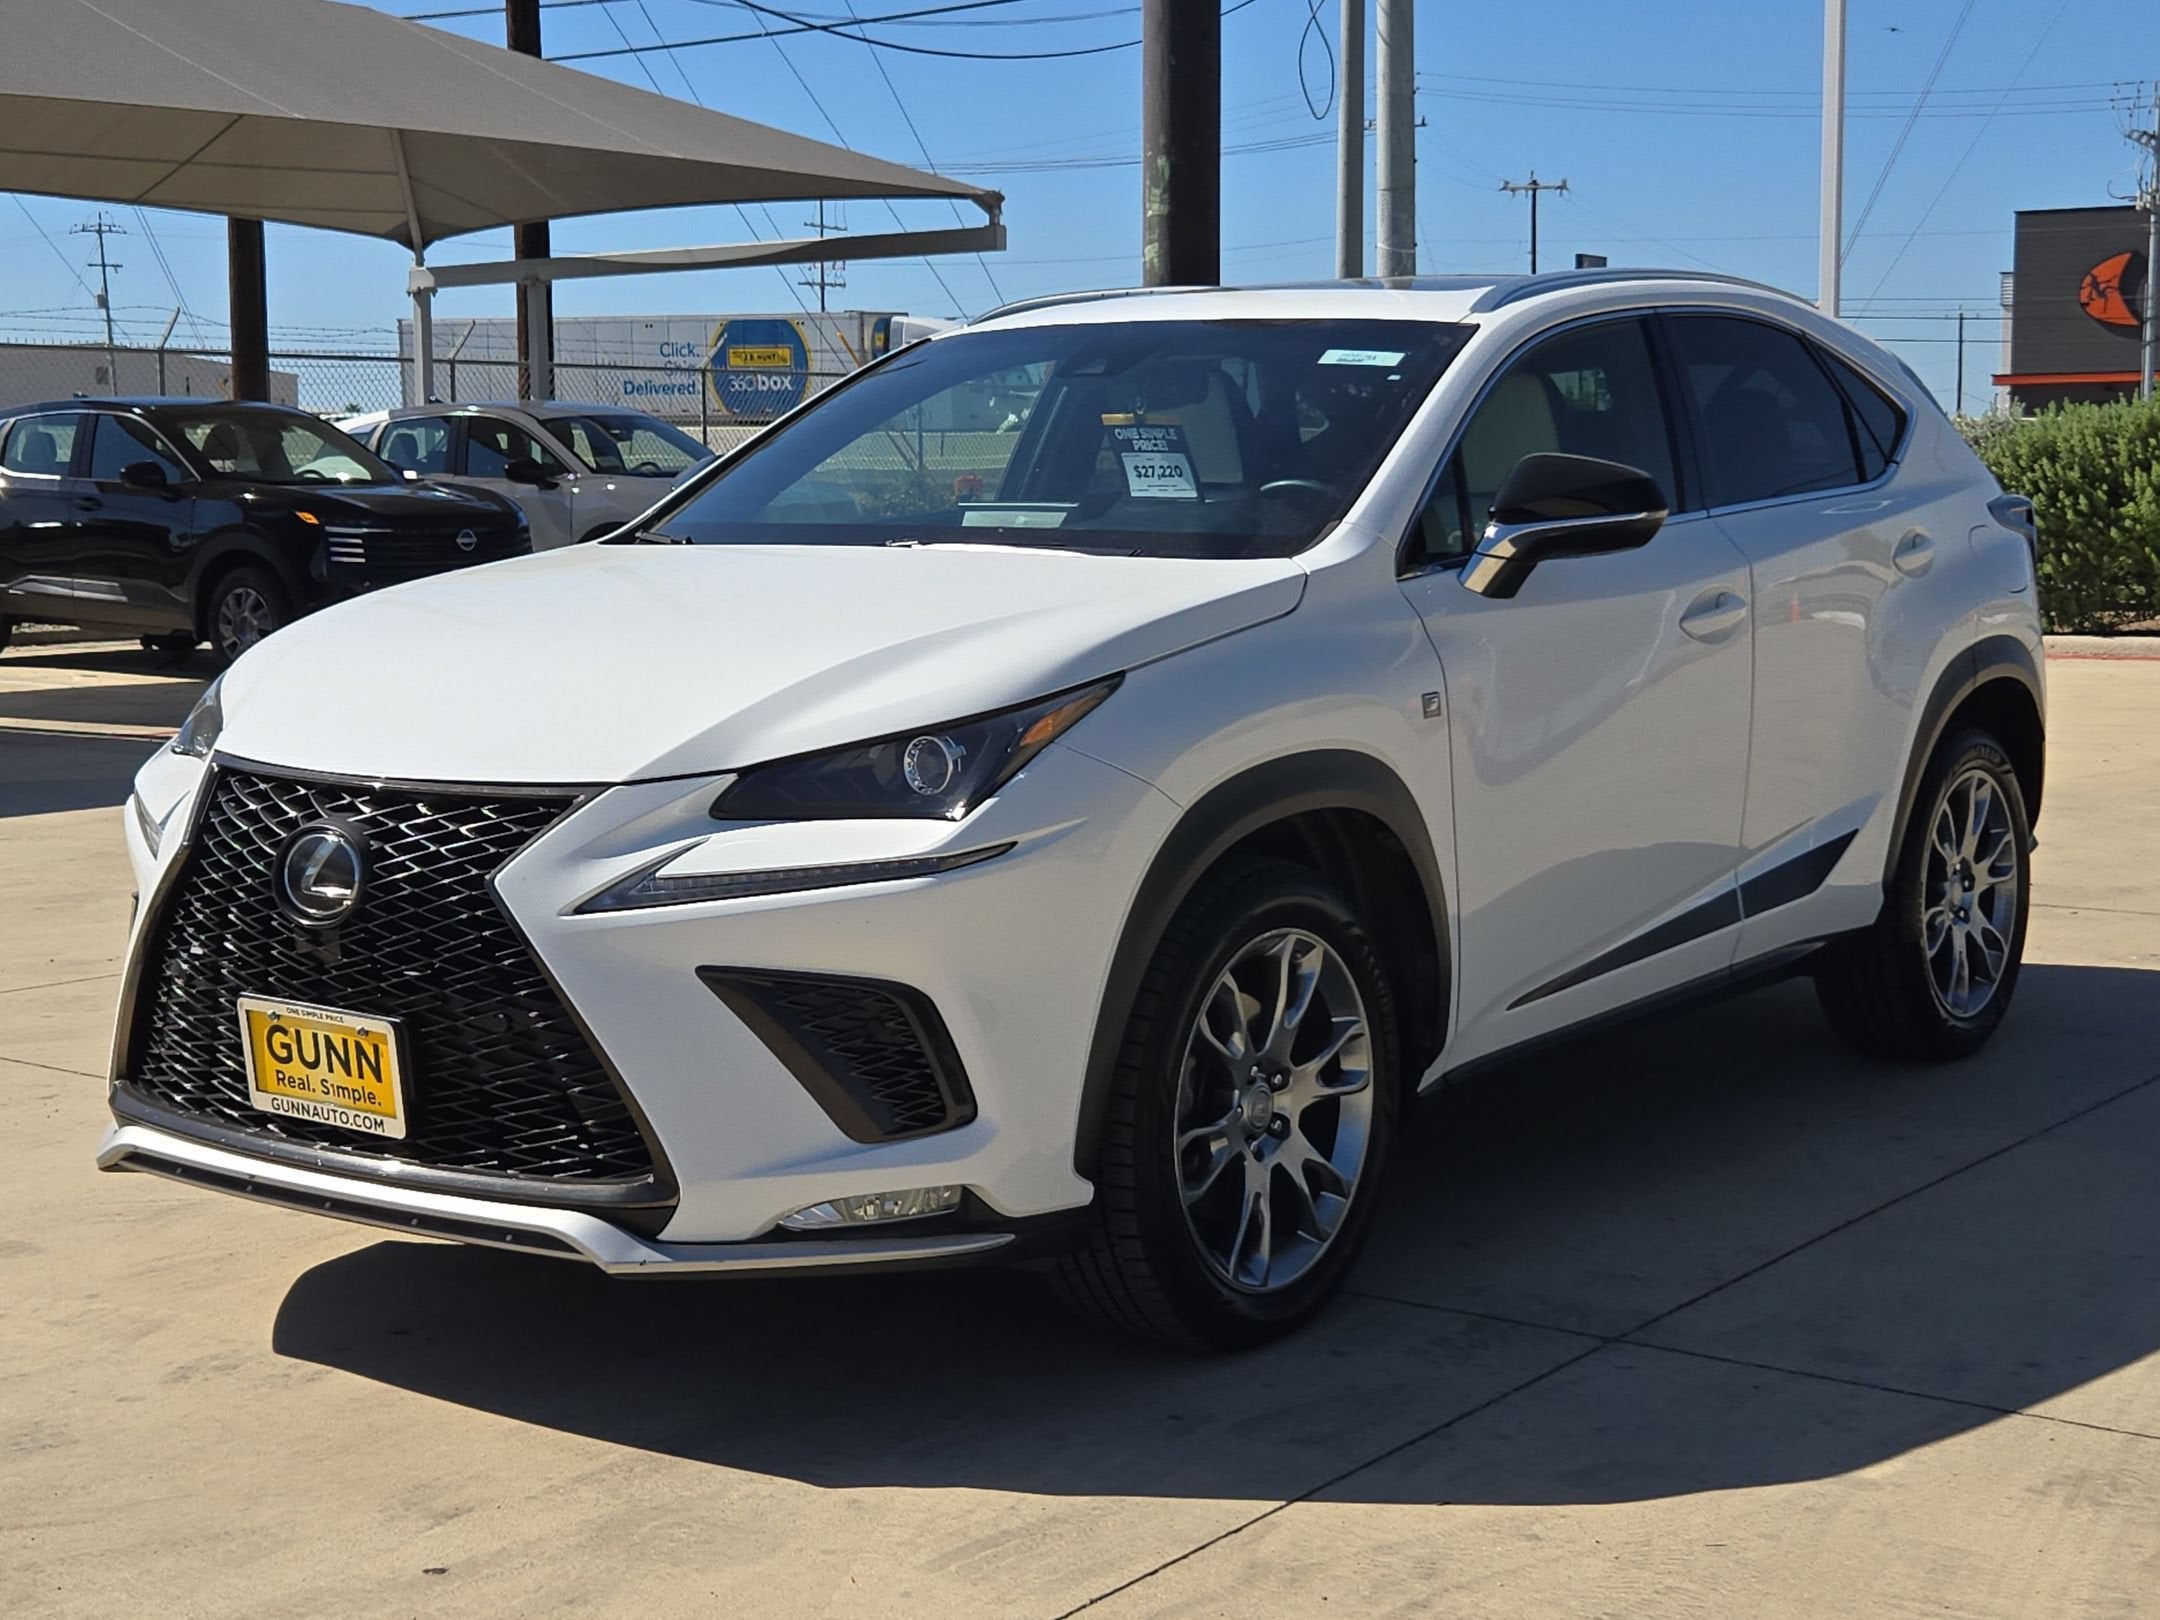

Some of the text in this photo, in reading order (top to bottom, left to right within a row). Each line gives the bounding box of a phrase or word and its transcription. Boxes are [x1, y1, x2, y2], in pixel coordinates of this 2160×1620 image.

[660, 342, 700, 358] Click.
[623, 379, 701, 396] Delivered.
[1114, 428, 1178, 440] ONE SIMPLE
[1133, 465, 1183, 481] $27,220
[286, 1006, 345, 1024] ONE SIMPLE PRICE
[265, 1024, 384, 1084] GUNN
[275, 1069, 317, 1094] Real.
[271, 1096, 386, 1134] GUNNAUTO.COM
